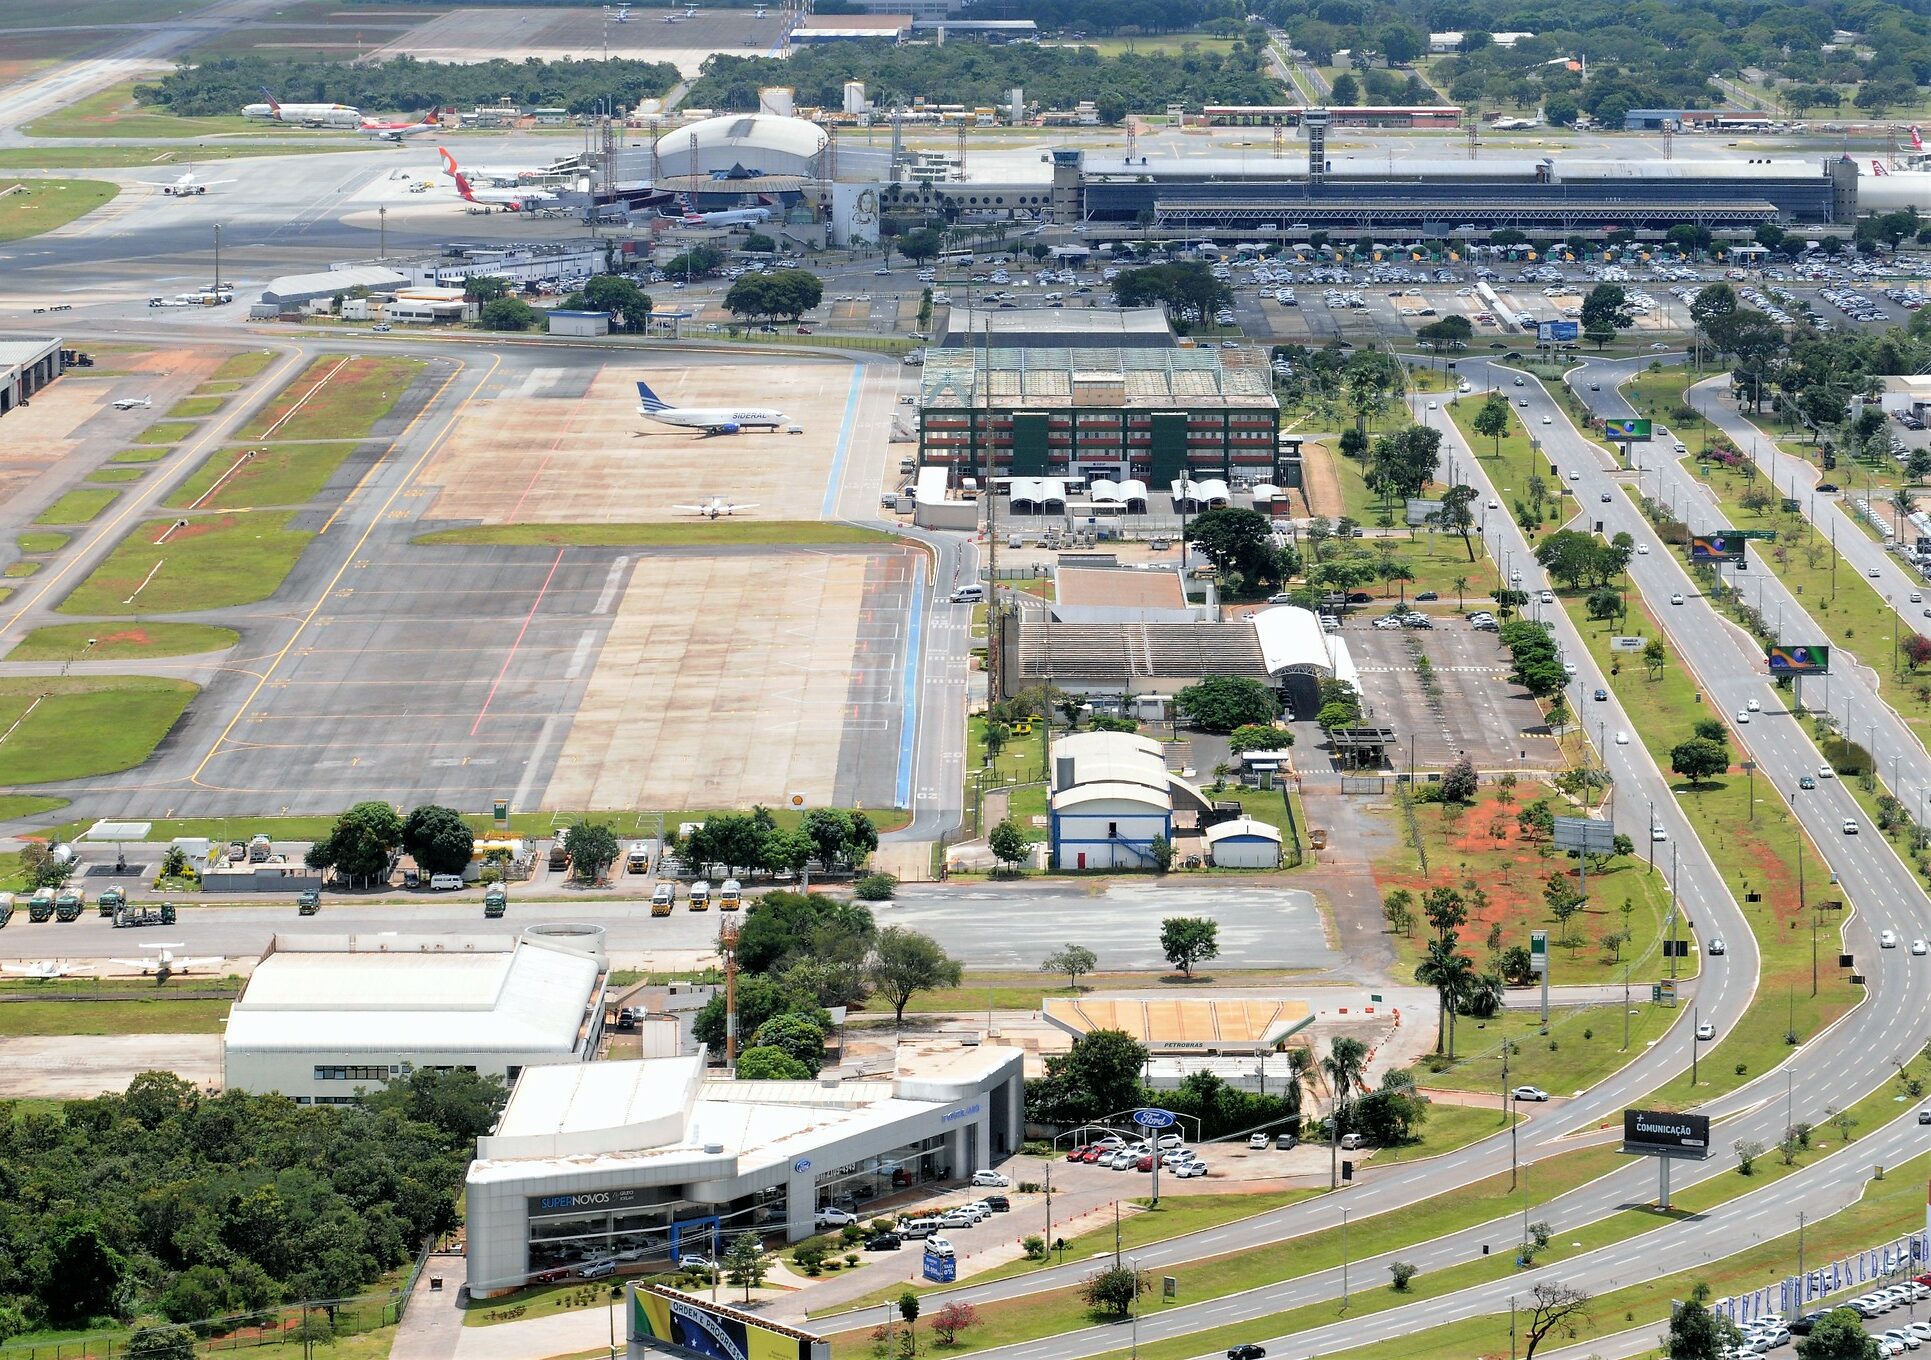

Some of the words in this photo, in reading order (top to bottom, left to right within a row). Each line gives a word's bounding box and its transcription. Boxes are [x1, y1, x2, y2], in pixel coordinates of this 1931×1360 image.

[1140, 1112, 1166, 1125] Ford
[1636, 1123, 1691, 1136] COMUNICAÇÃO
[541, 1192, 610, 1209] SUPERNOVOS
[673, 1301, 698, 1319] ORDEM
[699, 1315, 704, 1323] E
